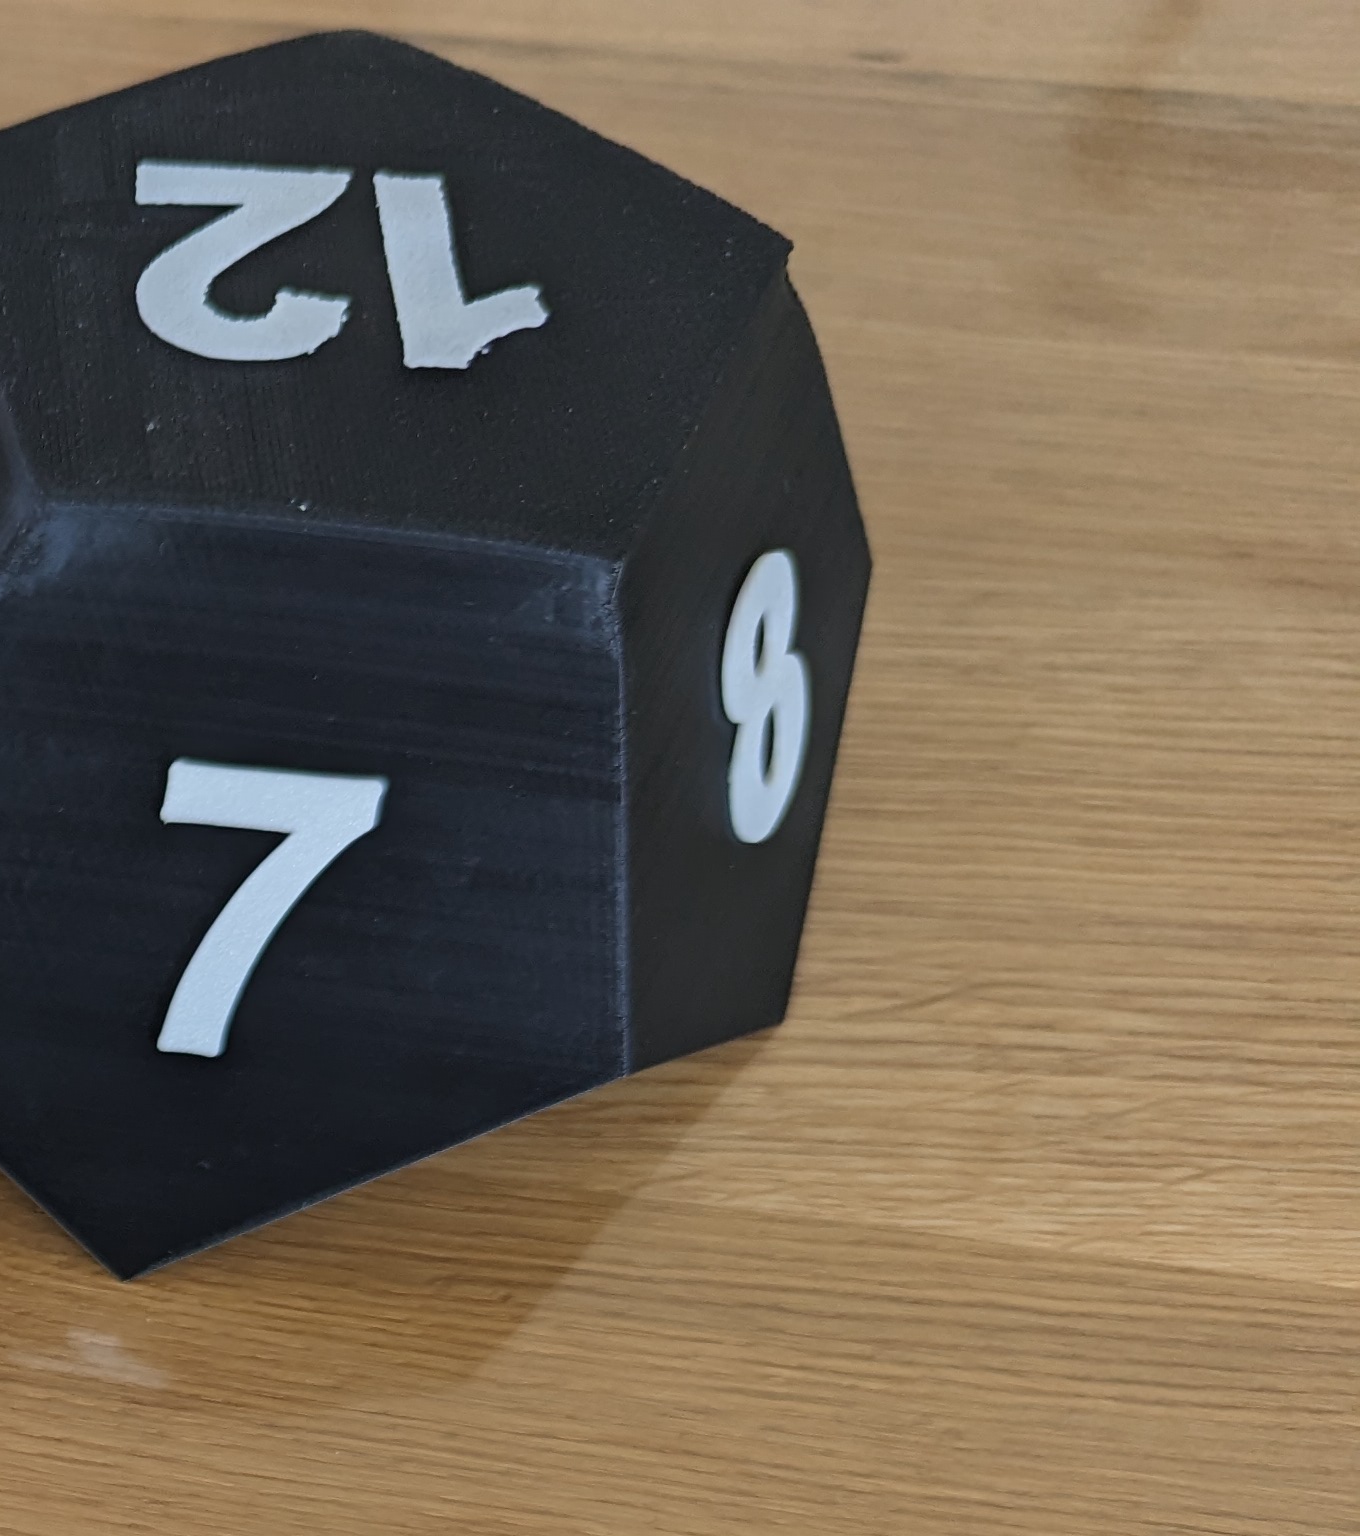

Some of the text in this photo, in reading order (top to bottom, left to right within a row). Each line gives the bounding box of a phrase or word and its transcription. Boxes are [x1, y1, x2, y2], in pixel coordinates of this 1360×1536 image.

[135, 161, 549, 370] 12
[721, 550, 810, 844] 8
[159, 758, 389, 1058] 7
